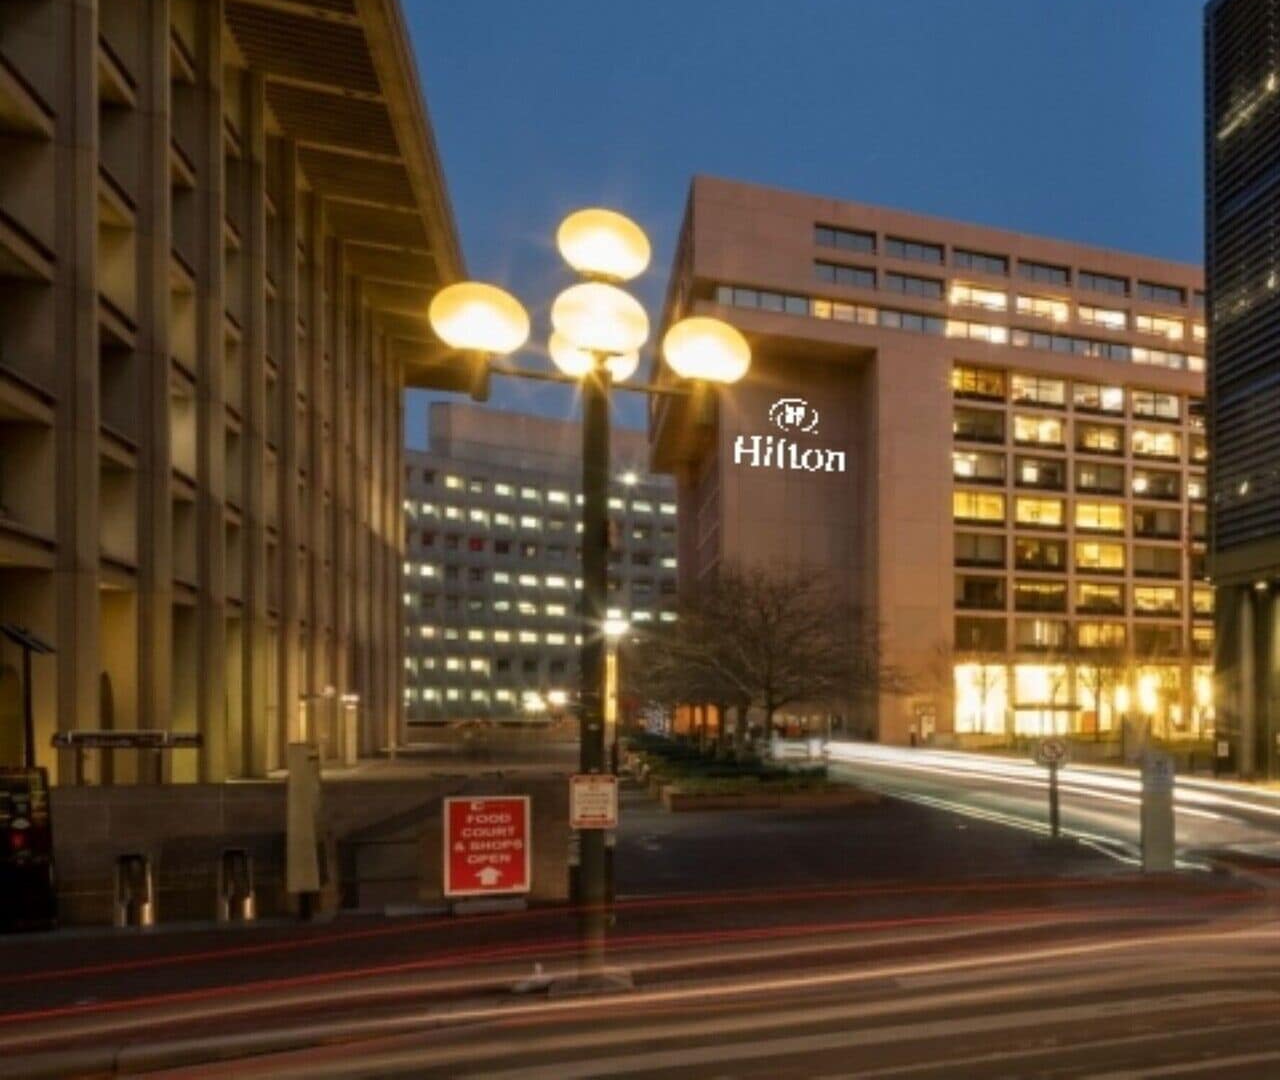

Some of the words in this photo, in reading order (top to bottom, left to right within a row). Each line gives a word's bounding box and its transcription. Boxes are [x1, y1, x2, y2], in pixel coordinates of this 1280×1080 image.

[734, 435, 845, 472] Hilton
[465, 813, 512, 824] FOOD
[462, 826, 515, 838] COURT
[470, 839, 522, 851] SHOPS
[467, 853, 512, 864] OPEN
